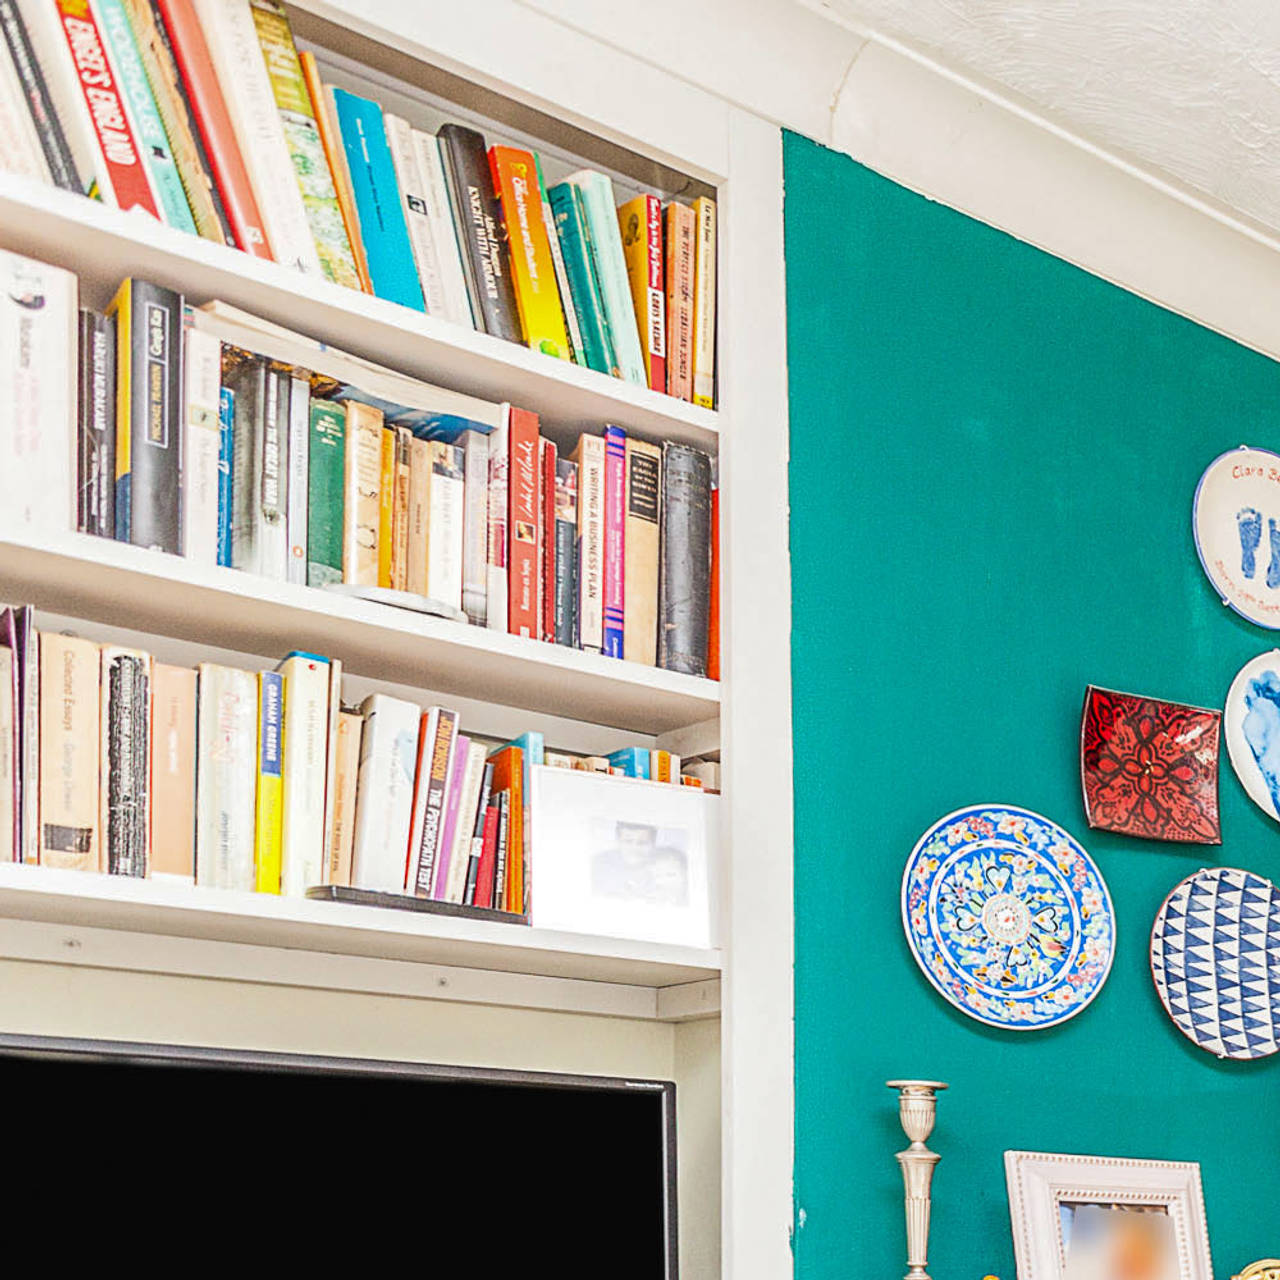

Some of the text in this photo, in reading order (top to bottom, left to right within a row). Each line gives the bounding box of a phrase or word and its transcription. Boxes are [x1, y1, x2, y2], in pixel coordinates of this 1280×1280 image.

[65, 17, 136, 165] ENGEL'S ENGLAND
[512, 177, 525, 203] Office
[517, 203, 528, 228] Home
[468, 186, 498, 298] KNIGHT WITH ARMOUR
[526, 244, 538, 279] Student
[94, 331, 105, 373] HARUKI
[94, 373, 105, 430] MURAKAMI
[265, 442, 277, 477] GREAT
[1232, 465, 1264, 479] Clara
[588, 466, 598, 510] WRITING
[588, 519, 598, 570] BUSINESS
[587, 571, 596, 599] PLAN
[63, 649, 75, 697] Collected
[61, 697, 75, 732] Essays
[265, 683, 278, 761] GRAHAM GREENE
[431, 717, 454, 781] JON RONSON
[416, 788, 443, 890] THE PSYCHOPATH TEST
